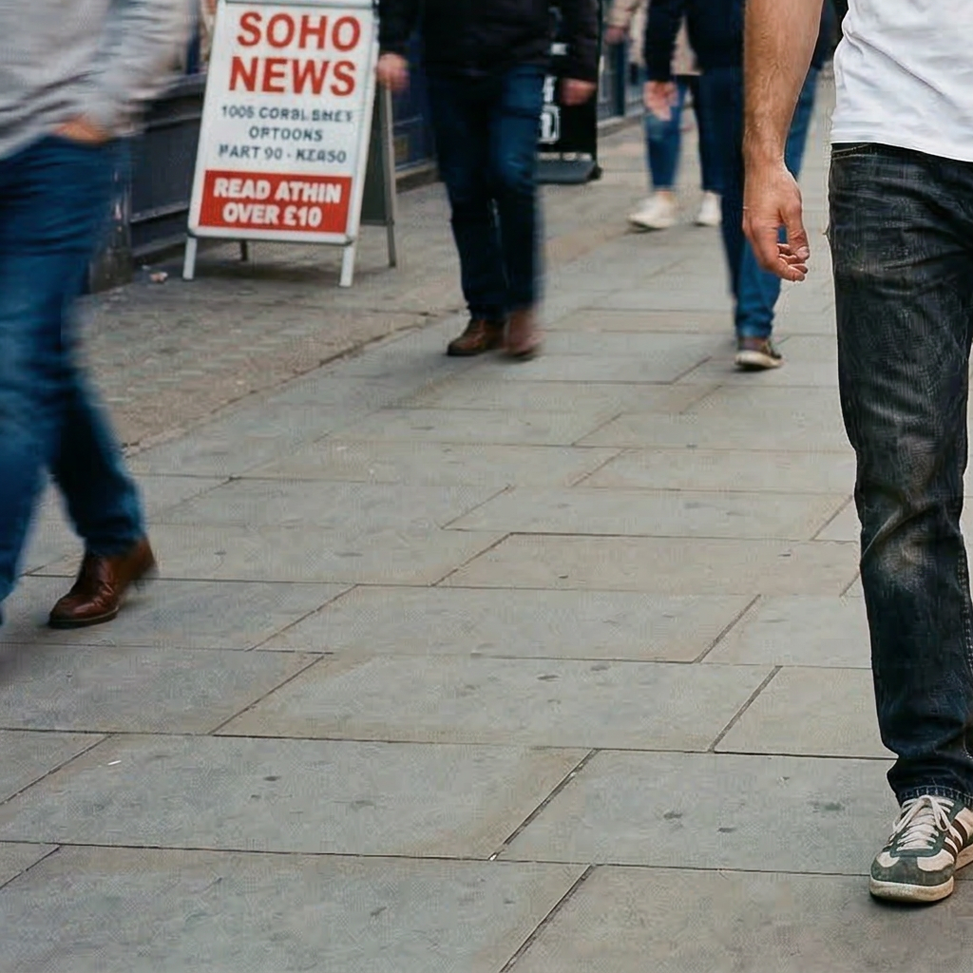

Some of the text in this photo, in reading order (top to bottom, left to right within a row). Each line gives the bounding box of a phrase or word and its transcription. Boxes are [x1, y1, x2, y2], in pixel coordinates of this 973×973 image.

[237, 11, 361, 52] SOHO
[229, 56, 356, 97] NEWS
[213, 177, 271, 200] READ
[222, 202, 322, 227] OVER £10
